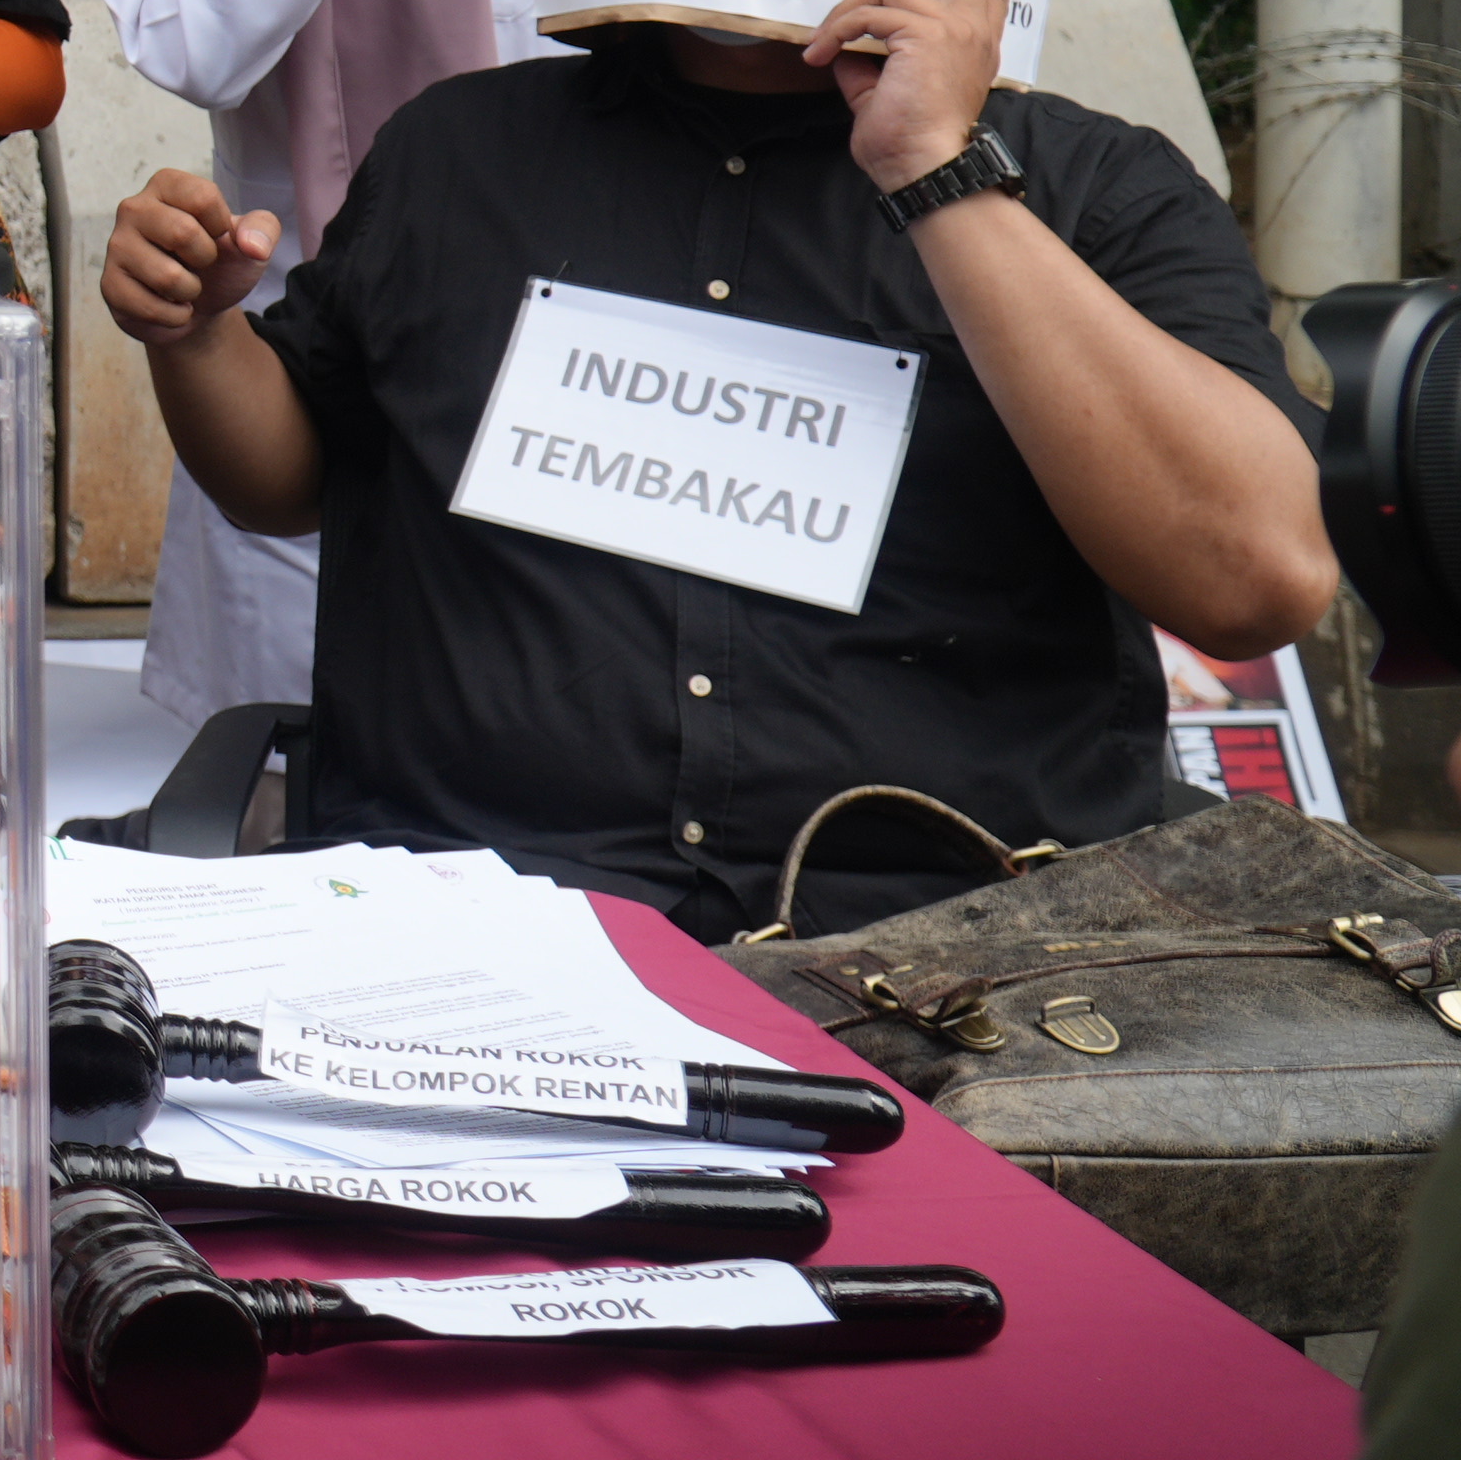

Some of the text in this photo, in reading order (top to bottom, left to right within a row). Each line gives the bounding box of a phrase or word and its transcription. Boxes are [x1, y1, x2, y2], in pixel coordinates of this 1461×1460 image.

[561, 348, 846, 448] INDUSTRI
[511, 425, 851, 544] TEMBAKAU
[269, 1046, 679, 1109] KE KELOMPOK RENTAN
[515, 1049, 646, 1071] ROKOK
[258, 1171, 539, 1204] HARGA ROKOK
[511, 1297, 658, 1323] ROKOK
